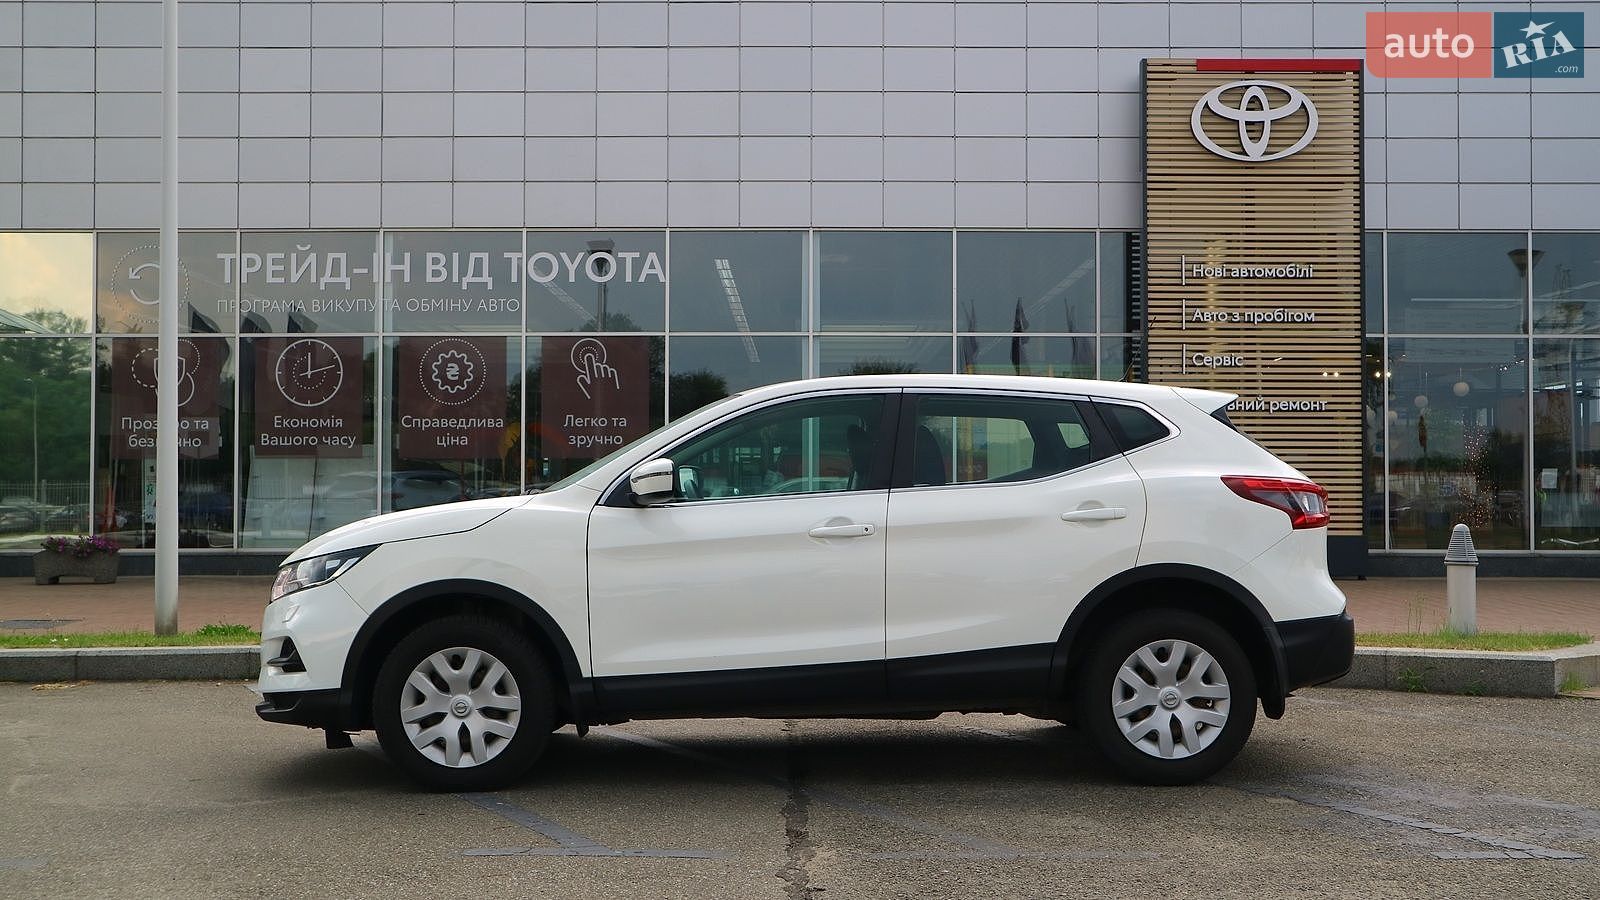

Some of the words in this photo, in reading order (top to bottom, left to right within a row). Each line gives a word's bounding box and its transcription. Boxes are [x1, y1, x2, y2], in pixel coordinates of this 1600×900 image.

[216, 244, 411, 290] ТРЕЙД-ІН
[425, 252, 493, 290] ВІД
[503, 252, 667, 283] TOYOTA
[1192, 264, 1226, 278] Нові
[1231, 263, 1314, 279] автомобілі
[217, 299, 306, 312] ПРОГРАМА
[311, 298, 378, 312] ВИКУПУ
[406, 298, 472, 312] ОБМІНУ
[478, 298, 520, 312] АВТО
[1192, 309, 1228, 322] Авто
[1232, 311, 1240, 322] з
[1244, 308, 1315, 325] пробігом
[1192, 353, 1244, 369] Сервіс
[1227, 395, 1265, 411] вний
[1269, 400, 1328, 414] ремонт
[194, 419, 209, 429] та
[274, 415, 343, 428] Економія
[401, 415, 504, 430] Справедлива
[563, 414, 608, 427] Легко
[611, 417, 627, 427] та
[261, 433, 319, 446] Вашого
[321, 435, 357, 448] часу
[436, 433, 468, 447] ціна
[568, 435, 623, 448] зручно
